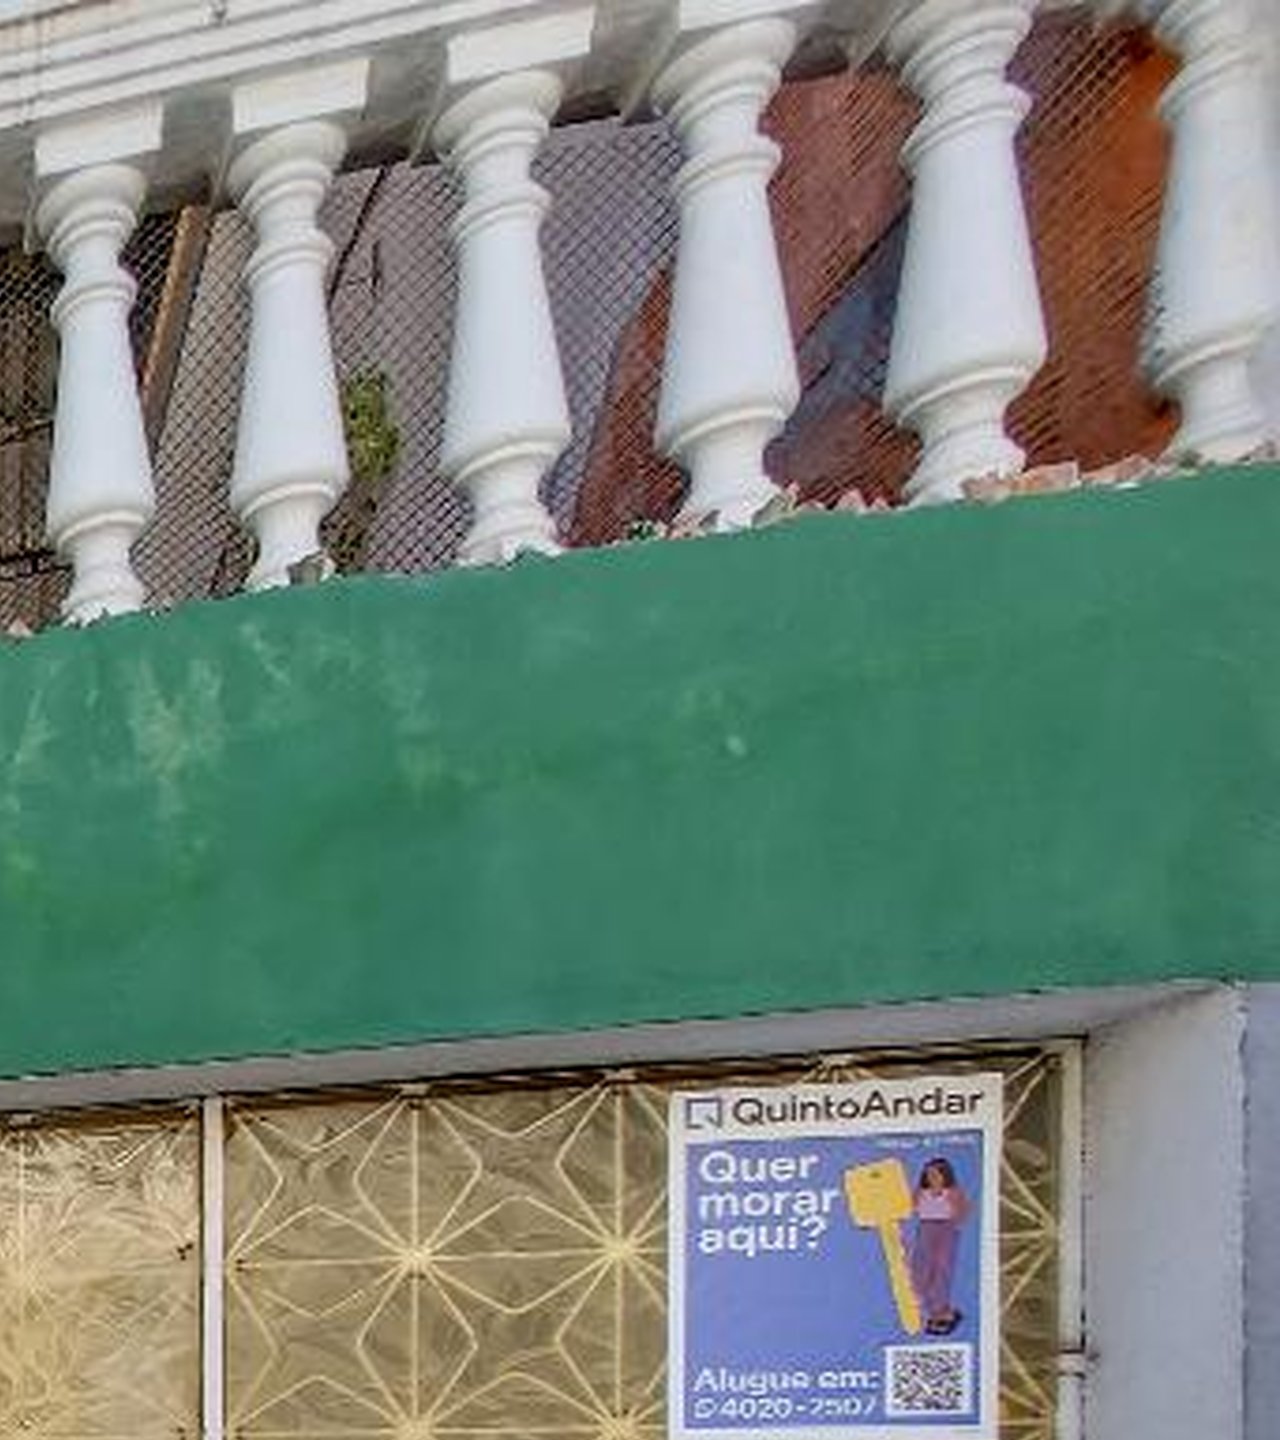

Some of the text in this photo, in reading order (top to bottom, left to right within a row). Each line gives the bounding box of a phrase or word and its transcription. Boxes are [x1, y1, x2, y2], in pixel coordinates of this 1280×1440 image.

[732, 1089, 984, 1127] QuintoAndar
[699, 1152, 819, 1184] Quer
[698, 1187, 839, 1217] morar
[698, 1216, 827, 1257] aqui?
[693, 1369, 881, 1397] Alugue em:
